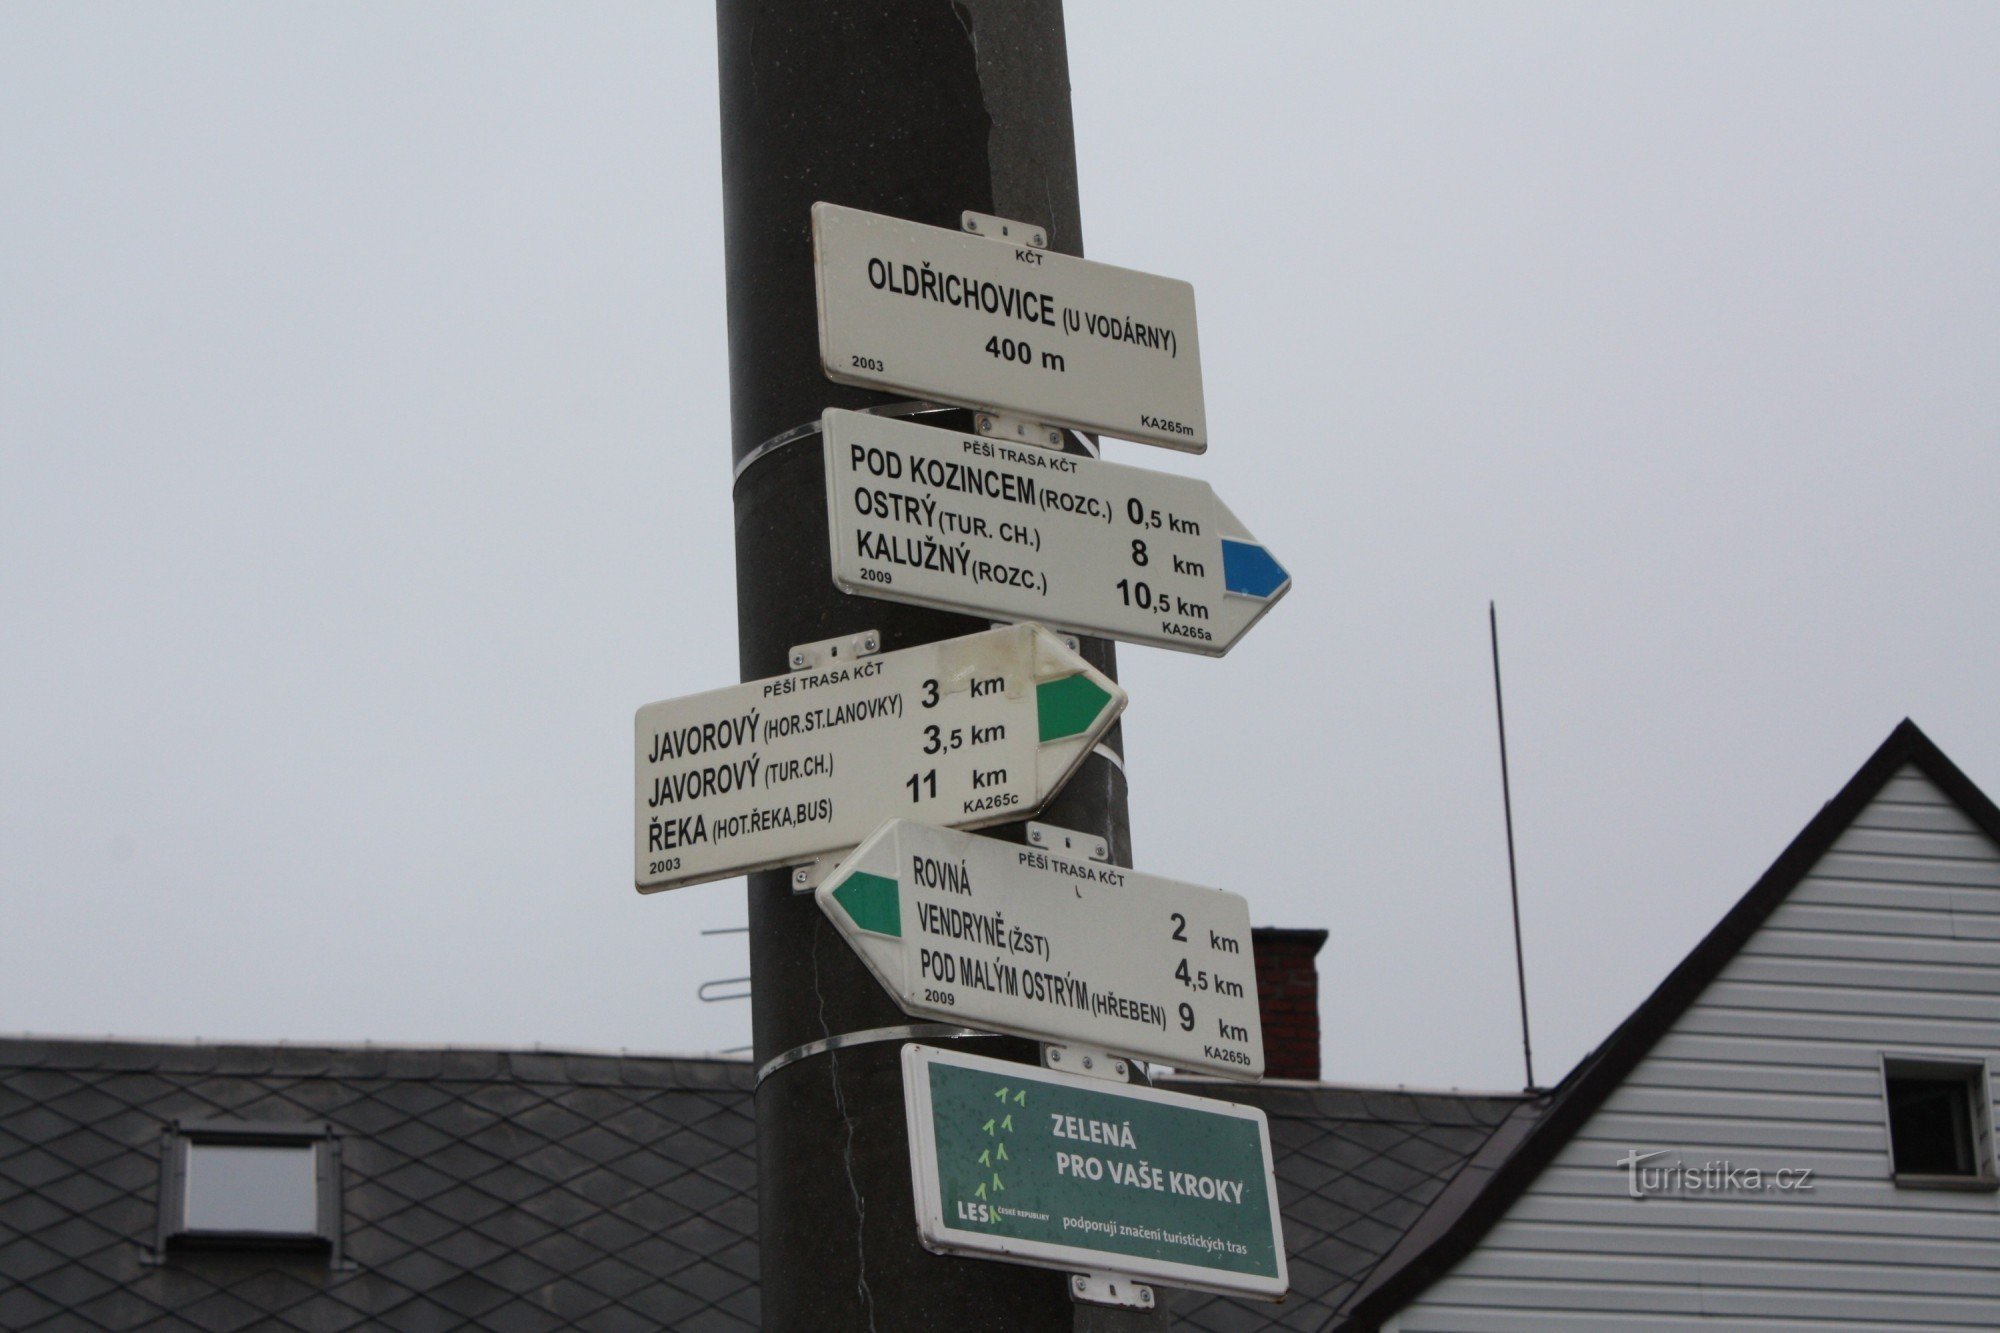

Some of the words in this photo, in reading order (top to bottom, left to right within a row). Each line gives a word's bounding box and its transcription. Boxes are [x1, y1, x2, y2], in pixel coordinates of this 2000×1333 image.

[1015, 249, 1043, 265] KČT
[868, 258, 1055, 327] OLDŘICHOVICE
[1063, 307, 1081, 335] (U
[1085, 311, 1176, 358] VODÁRNY)
[852, 356, 884, 372] 2003
[985, 337, 1032, 365] 400
[1042, 351, 1064, 371] m
[1141, 415, 1194, 436] KA265m
[963, 440, 996, 458] PĚŠÍ
[1000, 448, 1045, 468] TRASA
[1050, 456, 1077, 474] KČT
[851, 444, 902, 479] POD
[911, 456, 1035, 505] KOZINCEM
[1040, 488, 1112, 523] (ROZC.)
[1127, 497, 1162, 530] 0,5
[1168, 513, 1200, 536] km
[855, 487, 936, 527] OSTRÝ
[1132, 539, 1148, 566] 8
[1174, 554, 1204, 578] km
[857, 529, 971, 576] KALUŽNÝ
[972, 559, 1047, 595] (ROZC.)
[1116, 578, 1170, 615] 10,5
[1178, 596, 1209, 620] km
[860, 568, 892, 584] 2009
[1162, 621, 1212, 641] KA265a
[764, 677, 796, 698] PĚŠÍ
[800, 669, 850, 690] TRASA
[853, 662, 883, 682] KČT
[648, 707, 760, 764] JAVOROVÝ
[921, 678, 939, 708] 3
[971, 675, 1004, 698] km
[648, 752, 760, 808] JAVOROVÝ
[765, 752, 833, 789] (TUR.CH.)
[923, 725, 962, 755] 3,5
[971, 722, 1005, 745] km
[648, 813, 708, 852] ŘEKA
[906, 769, 936, 803] 11
[973, 767, 1007, 790] km
[964, 793, 1018, 814] KA265c
[649, 858, 681, 875] 2003
[1019, 851, 1048, 870] PĚŠÍ
[1052, 860, 1095, 881] TRASA
[1099, 867, 1124, 887] KČT
[913, 855, 971, 896] ROVNÁ
[1170, 913, 1187, 942] 2
[1210, 930, 1239, 954] km
[918, 901, 1006, 948] VENDRYNĚ
[1008, 926, 1049, 962] (ŽST)
[1175, 957, 1208, 990] 4,5
[1214, 974, 1243, 998] km
[920, 947, 955, 984] POD
[960, 956, 1018, 997] MALÝM
[1023, 971, 1088, 1011] OSTRÝM
[1092, 990, 1166, 1031] (HŘEBEN)
[1178, 1002, 1194, 1031] 9
[1218, 1018, 1248, 1043] km
[925, 989, 954, 1005] 2009
[1204, 1046, 1250, 1066] KA265b
[1051, 1113, 1136, 1150] ZELENÁ
[1057, 1152, 1103, 1180] PRO
[1107, 1158, 1164, 1191] VAŠE
[1170, 1172, 1243, 1205] KROKY
[997, 1207, 1015, 1216] ČESKÉ
[1017, 1209, 1049, 1221] REPUBLIKY
[1063, 1216, 1117, 1236] podporují
[1120, 1224, 1161, 1241] značení
[1163, 1229, 1223, 1253] turistických
[1227, 1240, 1247, 1255] tras
